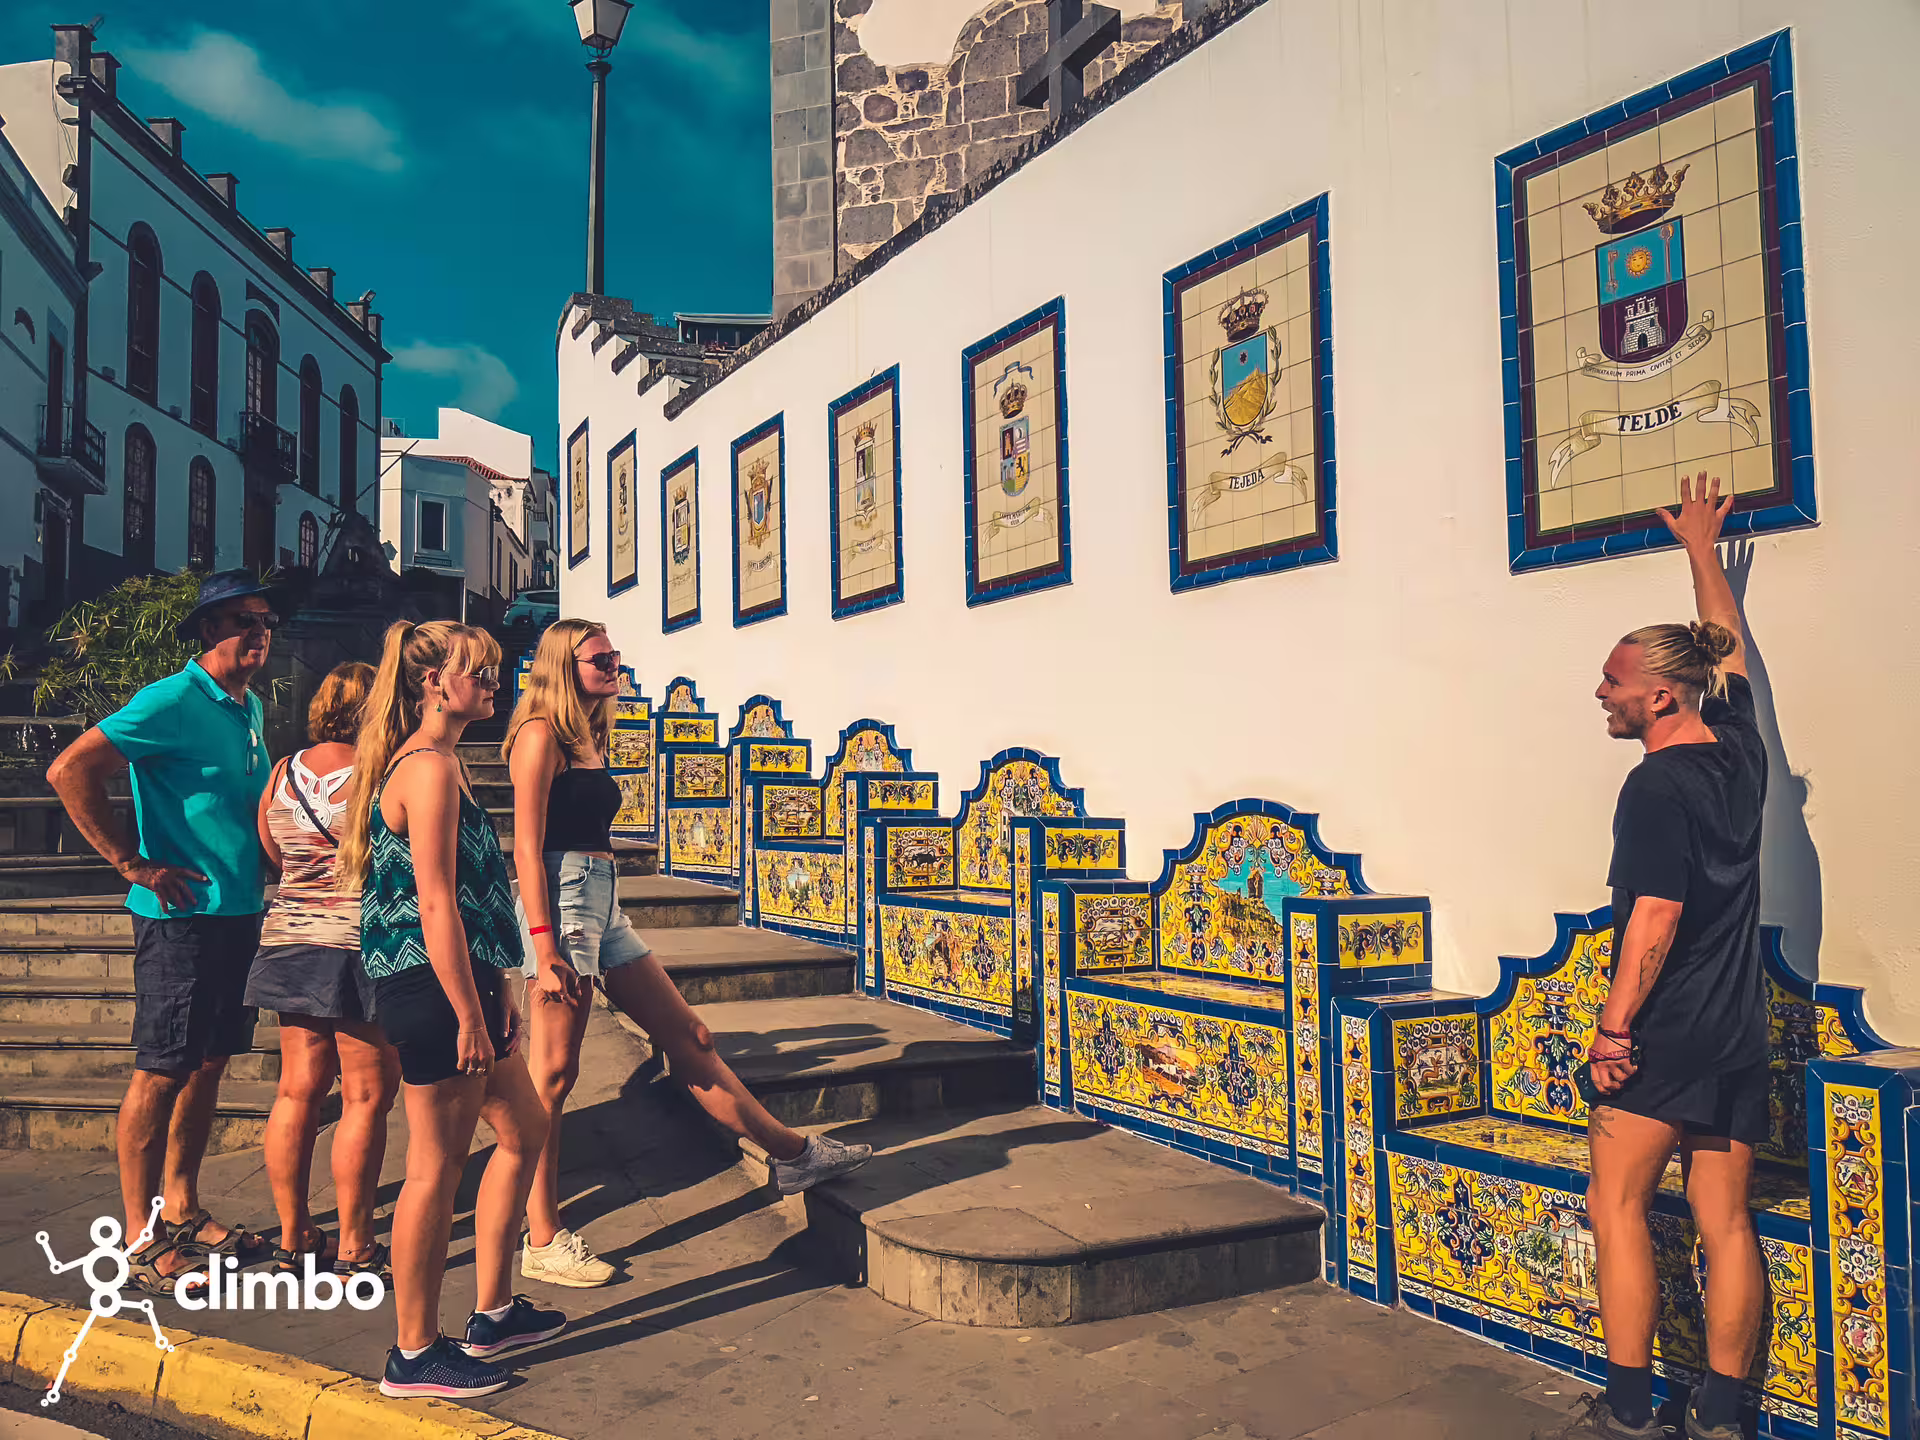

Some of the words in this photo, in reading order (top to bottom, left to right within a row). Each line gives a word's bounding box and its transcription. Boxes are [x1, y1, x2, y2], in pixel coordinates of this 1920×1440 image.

[1625, 369, 1647, 377] PRIMA
[1650, 356, 1674, 372] CIVITAS
[1675, 350, 1683, 359] ET
[1688, 334, 1707, 350] SEDES
[1617, 401, 1682, 432] TELDE
[1228, 468, 1265, 490] TEJEDA
